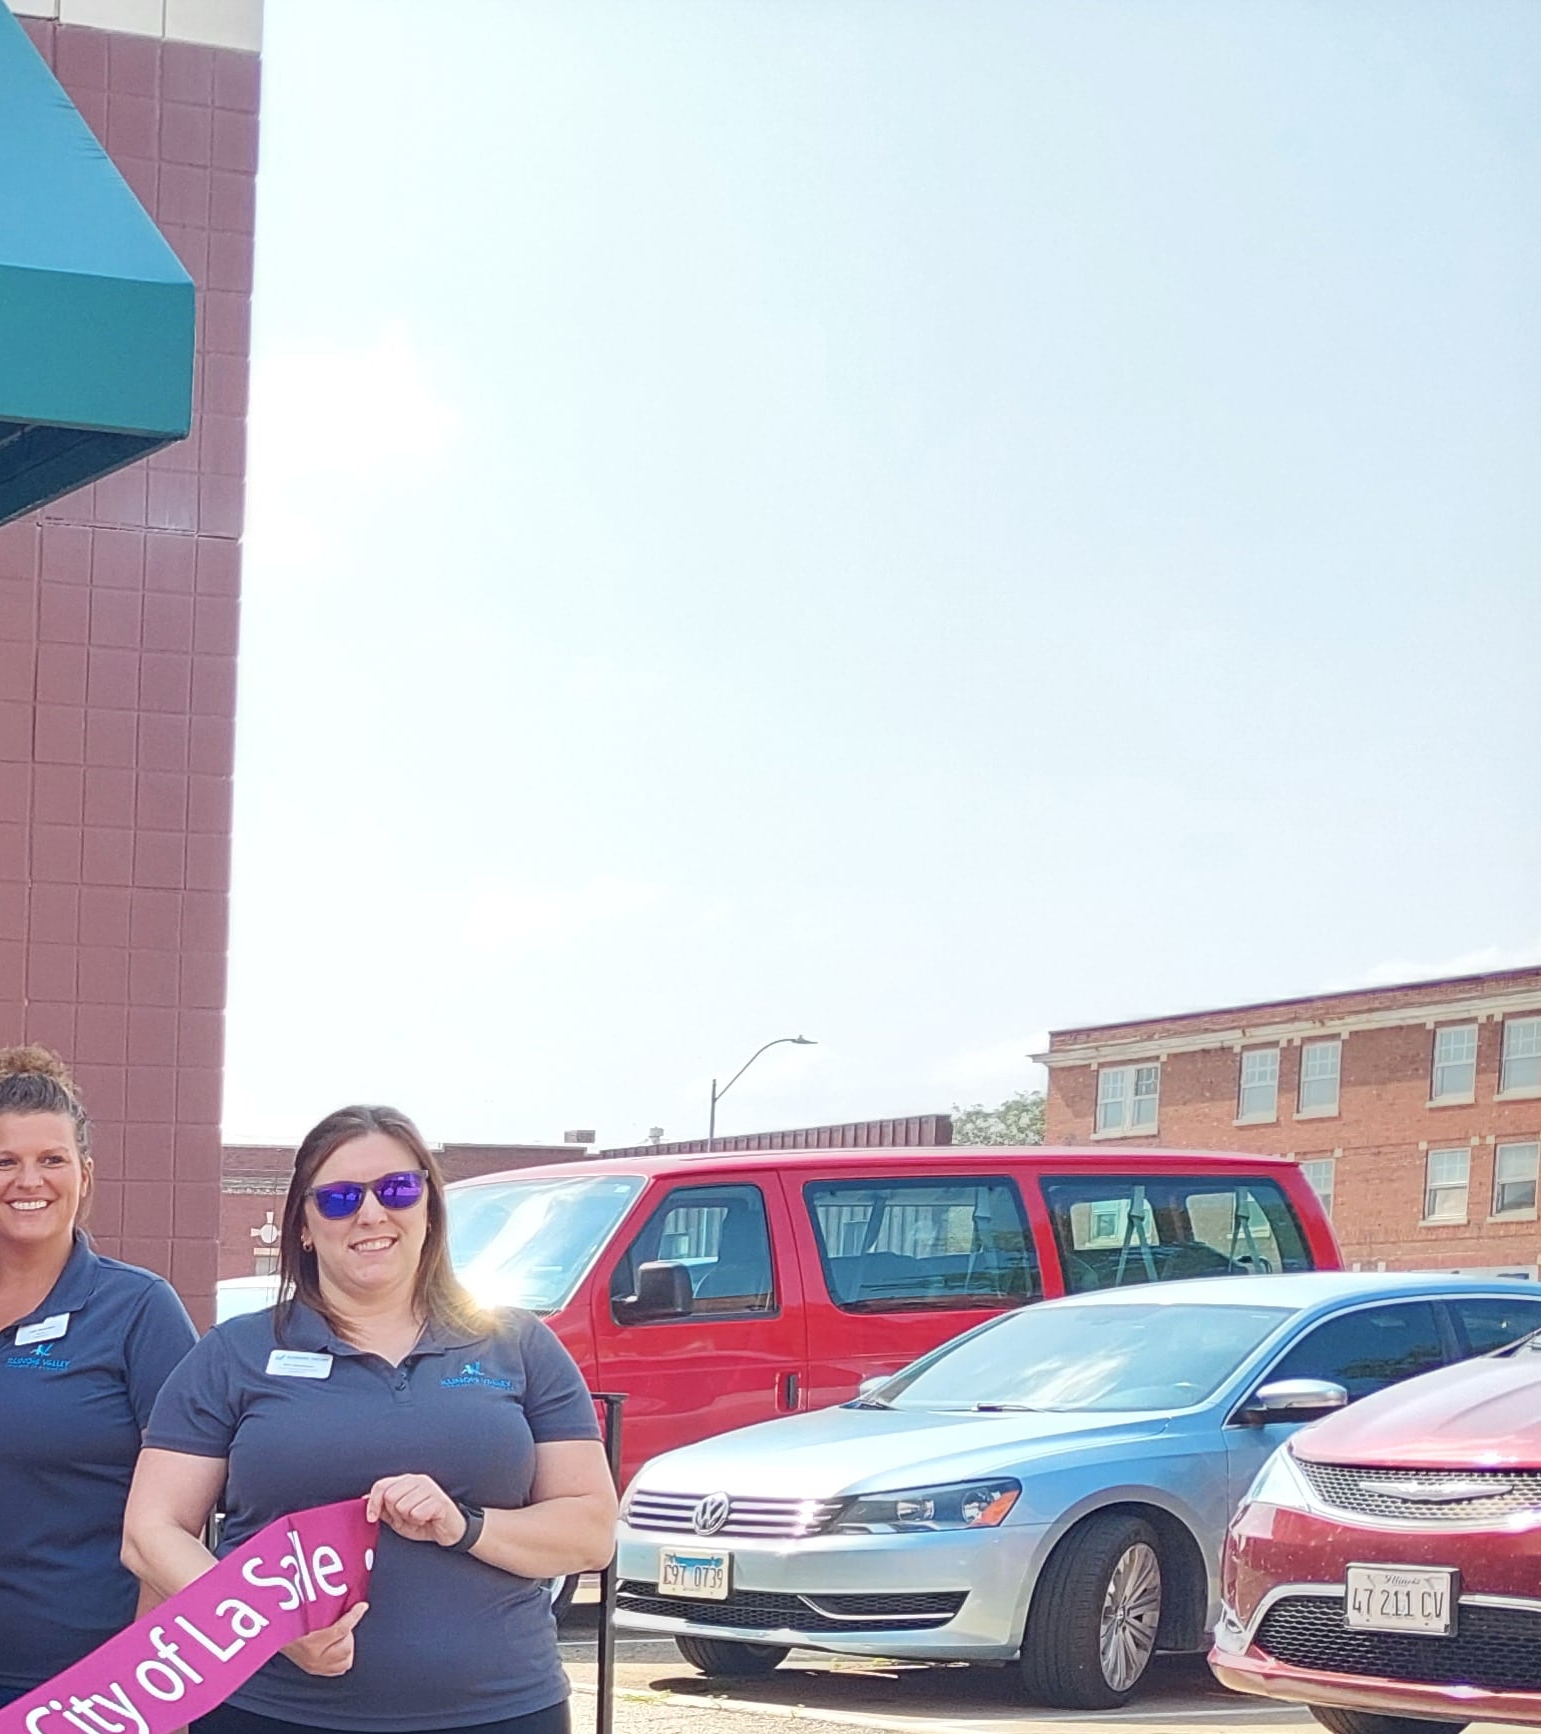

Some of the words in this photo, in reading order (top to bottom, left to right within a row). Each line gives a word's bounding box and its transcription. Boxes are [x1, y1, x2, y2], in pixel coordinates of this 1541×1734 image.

[694, 1565, 724, 1590] 0739
[1351, 1587, 1374, 1616] 47
[1380, 1588, 1415, 1618] 211
[1421, 1591, 1445, 1619] CV
[135, 1626, 205, 1702] of
[174, 1599, 271, 1663] La
